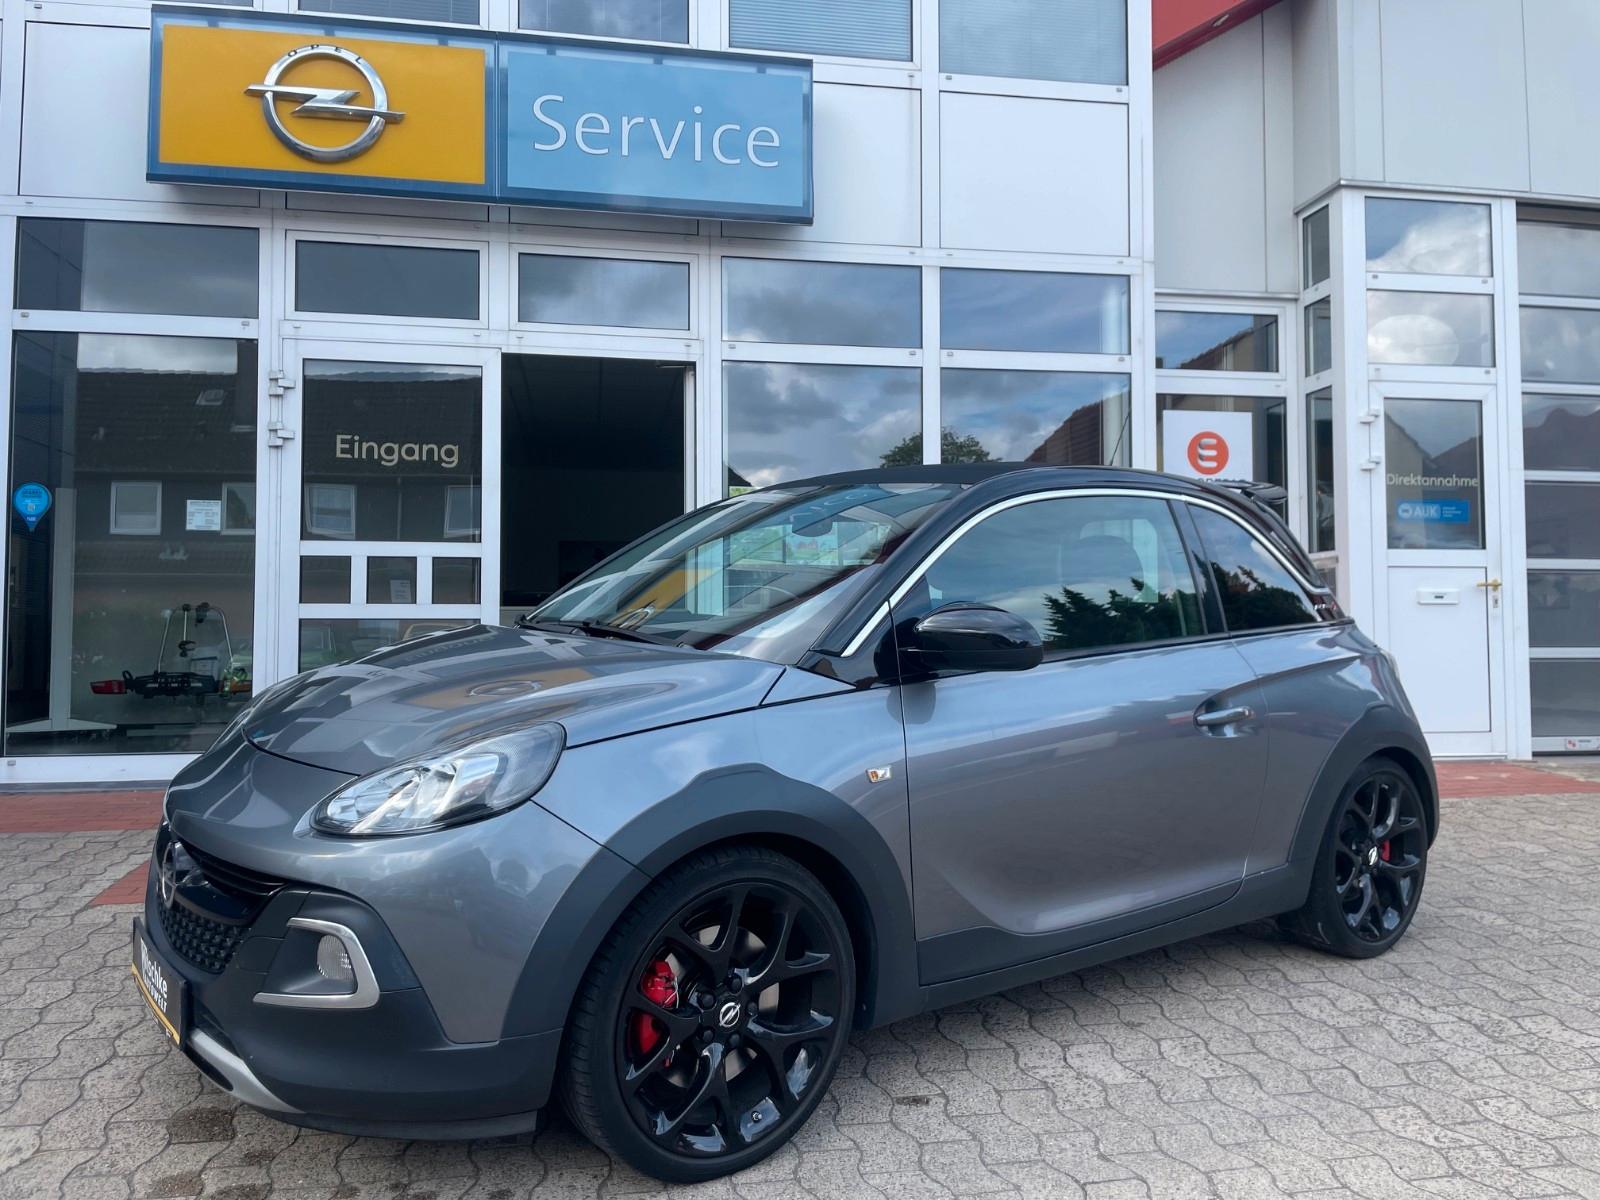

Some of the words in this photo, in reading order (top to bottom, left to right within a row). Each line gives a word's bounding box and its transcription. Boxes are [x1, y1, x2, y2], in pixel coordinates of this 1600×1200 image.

[288, 44, 363, 65] OPEL
[532, 94, 781, 168] Service
[336, 434, 459, 468] Eingang
[1387, 473, 1480, 487] Direktannahme
